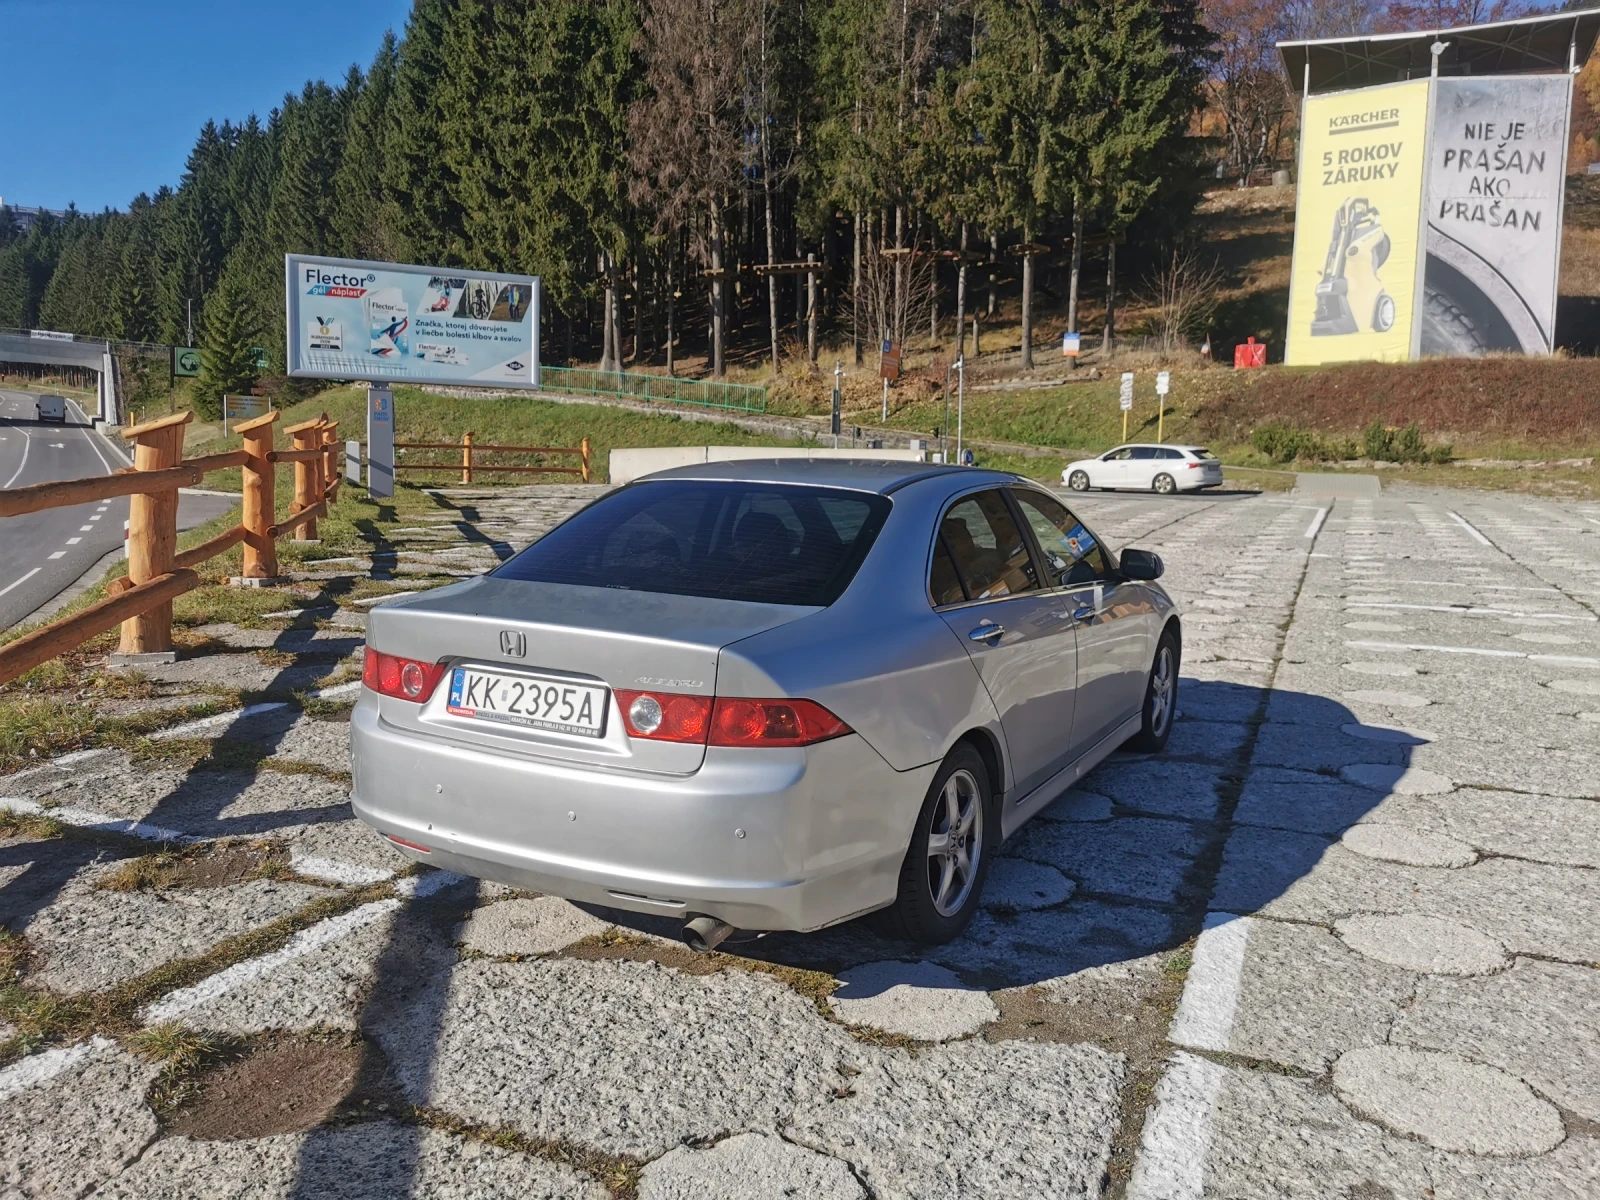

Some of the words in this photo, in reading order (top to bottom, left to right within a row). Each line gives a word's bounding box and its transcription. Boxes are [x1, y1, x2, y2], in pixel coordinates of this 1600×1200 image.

[1329, 108, 1400, 128] KÄRCHER
[1464, 123, 1496, 141] NIE
[1500, 122, 1525, 140] JE
[1322, 151, 1333, 167] 5
[1338, 141, 1403, 165] ROKOV
[1443, 142, 1546, 175] PRAŠAN
[1322, 161, 1399, 186] ZÁRUKY
[1469, 175, 1511, 197] AKO
[1439, 199, 1542, 231] PRAŠAN
[312, 286, 326, 295] gél
[415, 319, 444, 329] Značka,
[445, 322, 467, 331] ktorej
[468, 325, 508, 333] dôverujete
[421, 329, 444, 337] liečbe
[445, 331, 471, 339] bolesti
[451, 692, 460, 702] PL
[466, 675, 500, 710] KK
[508, 681, 593, 725] 2395A
